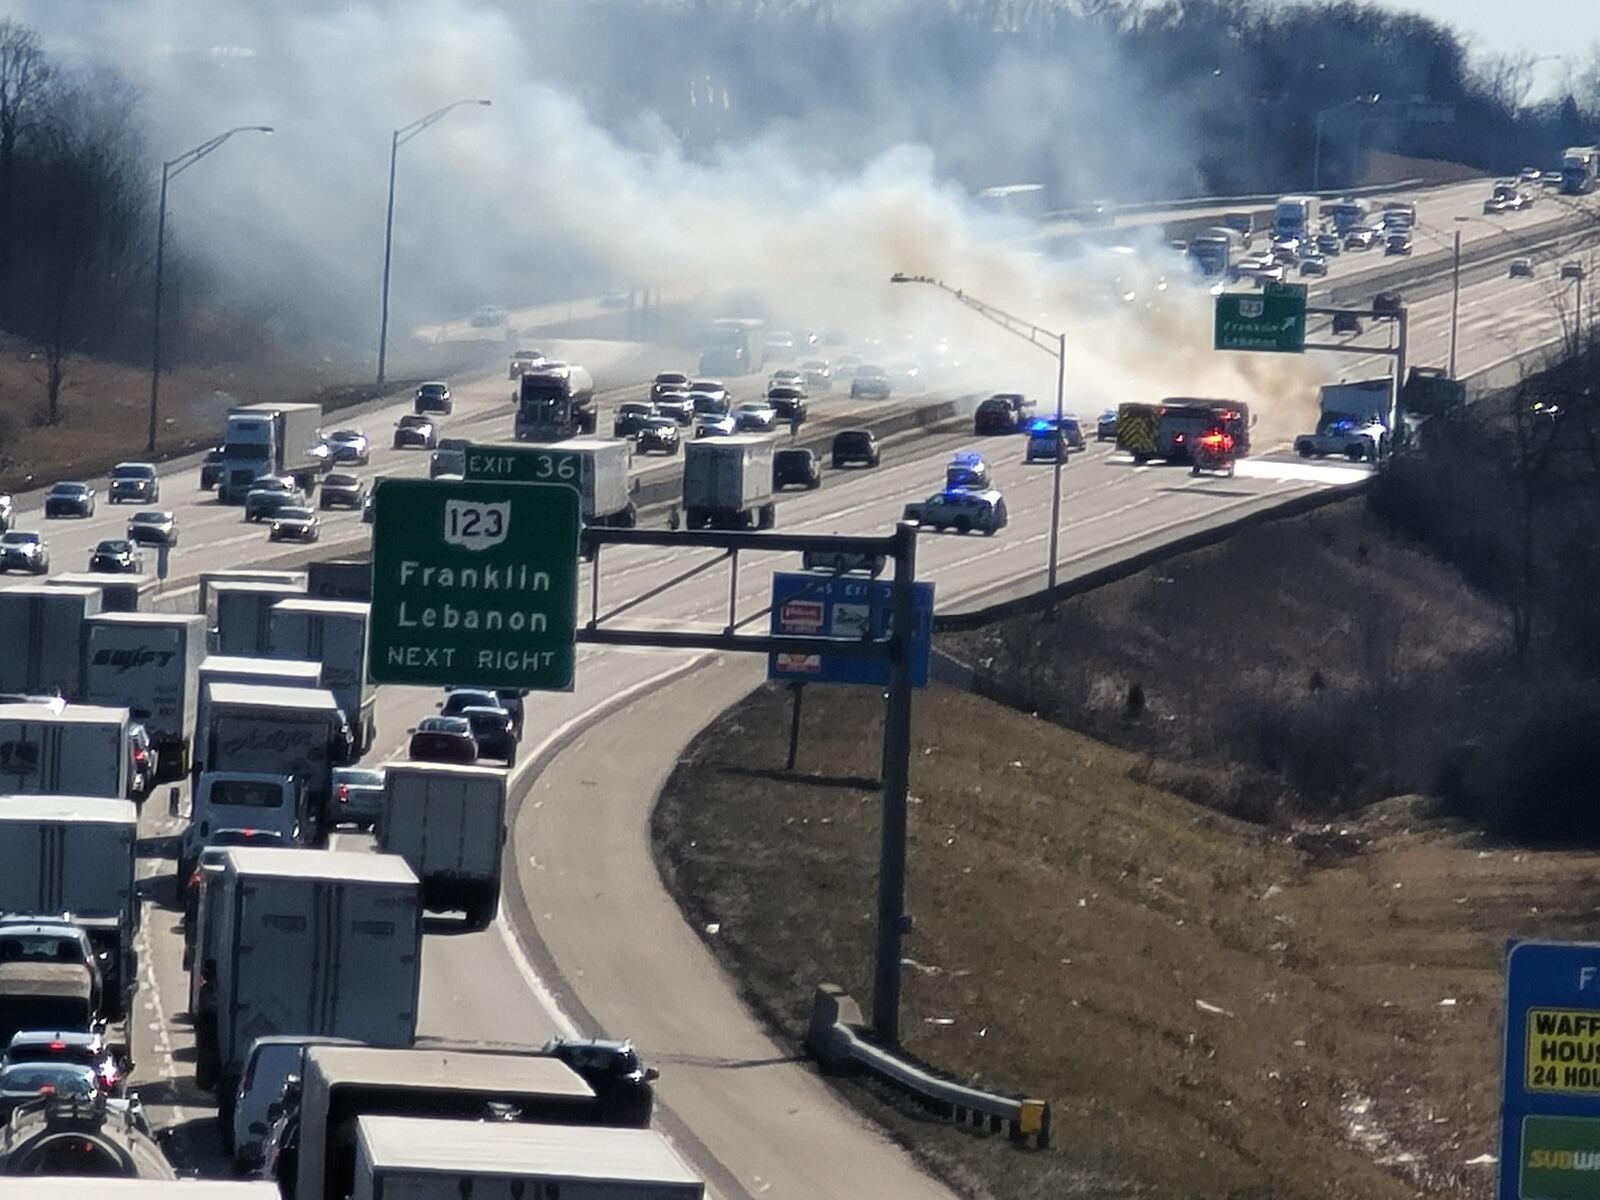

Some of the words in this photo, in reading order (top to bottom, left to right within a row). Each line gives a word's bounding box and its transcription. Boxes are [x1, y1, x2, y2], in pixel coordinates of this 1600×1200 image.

[470, 455, 516, 473] EXIT
[536, 455, 575, 478] 36
[449, 508, 503, 537] 123
[400, 561, 550, 591] Franklin
[398, 601, 548, 632] Lebanon
[388, 647, 456, 667] NEXT
[478, 650, 555, 671] RIGHT
[1533, 1065, 1558, 1086] 24
